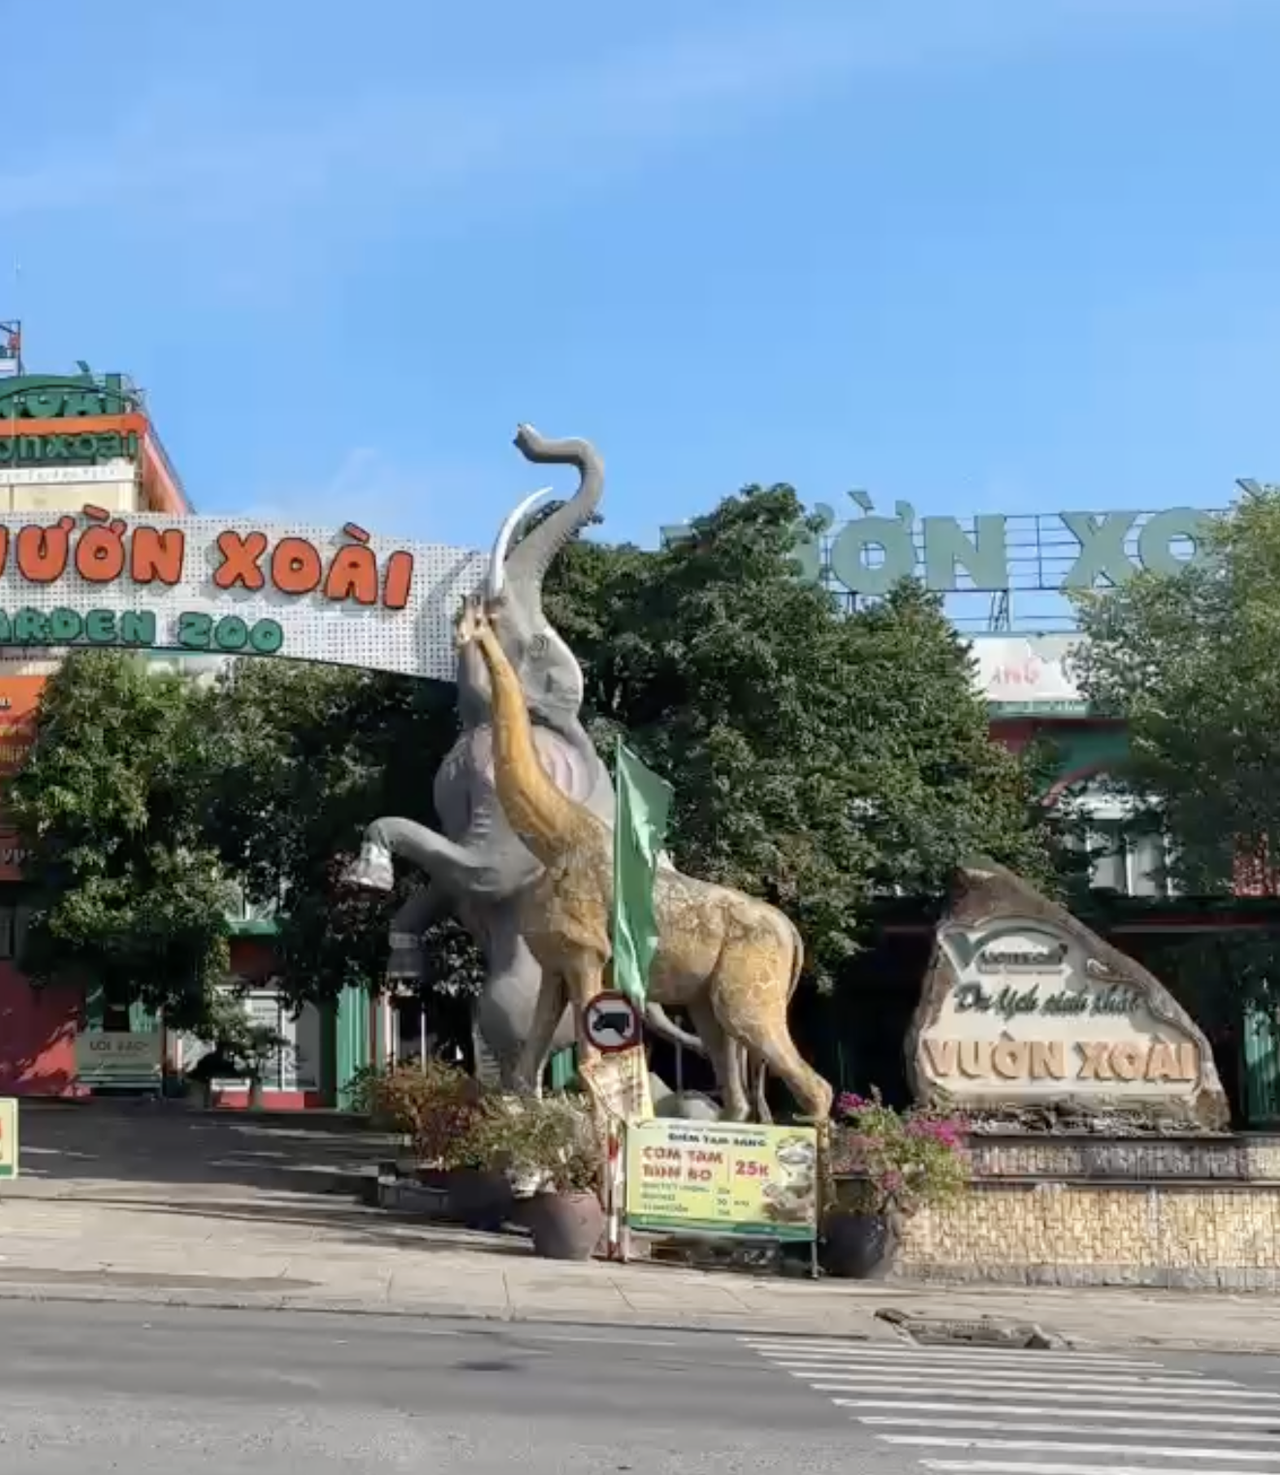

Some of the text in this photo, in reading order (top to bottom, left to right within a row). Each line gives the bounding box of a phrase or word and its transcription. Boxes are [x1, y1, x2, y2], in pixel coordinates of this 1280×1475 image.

[212, 521, 415, 611] XOÀI
[177, 611, 284, 653] ZOO
[1074, 1034, 1200, 1082] XOÀI
[735, 1159, 770, 1178] 25K
